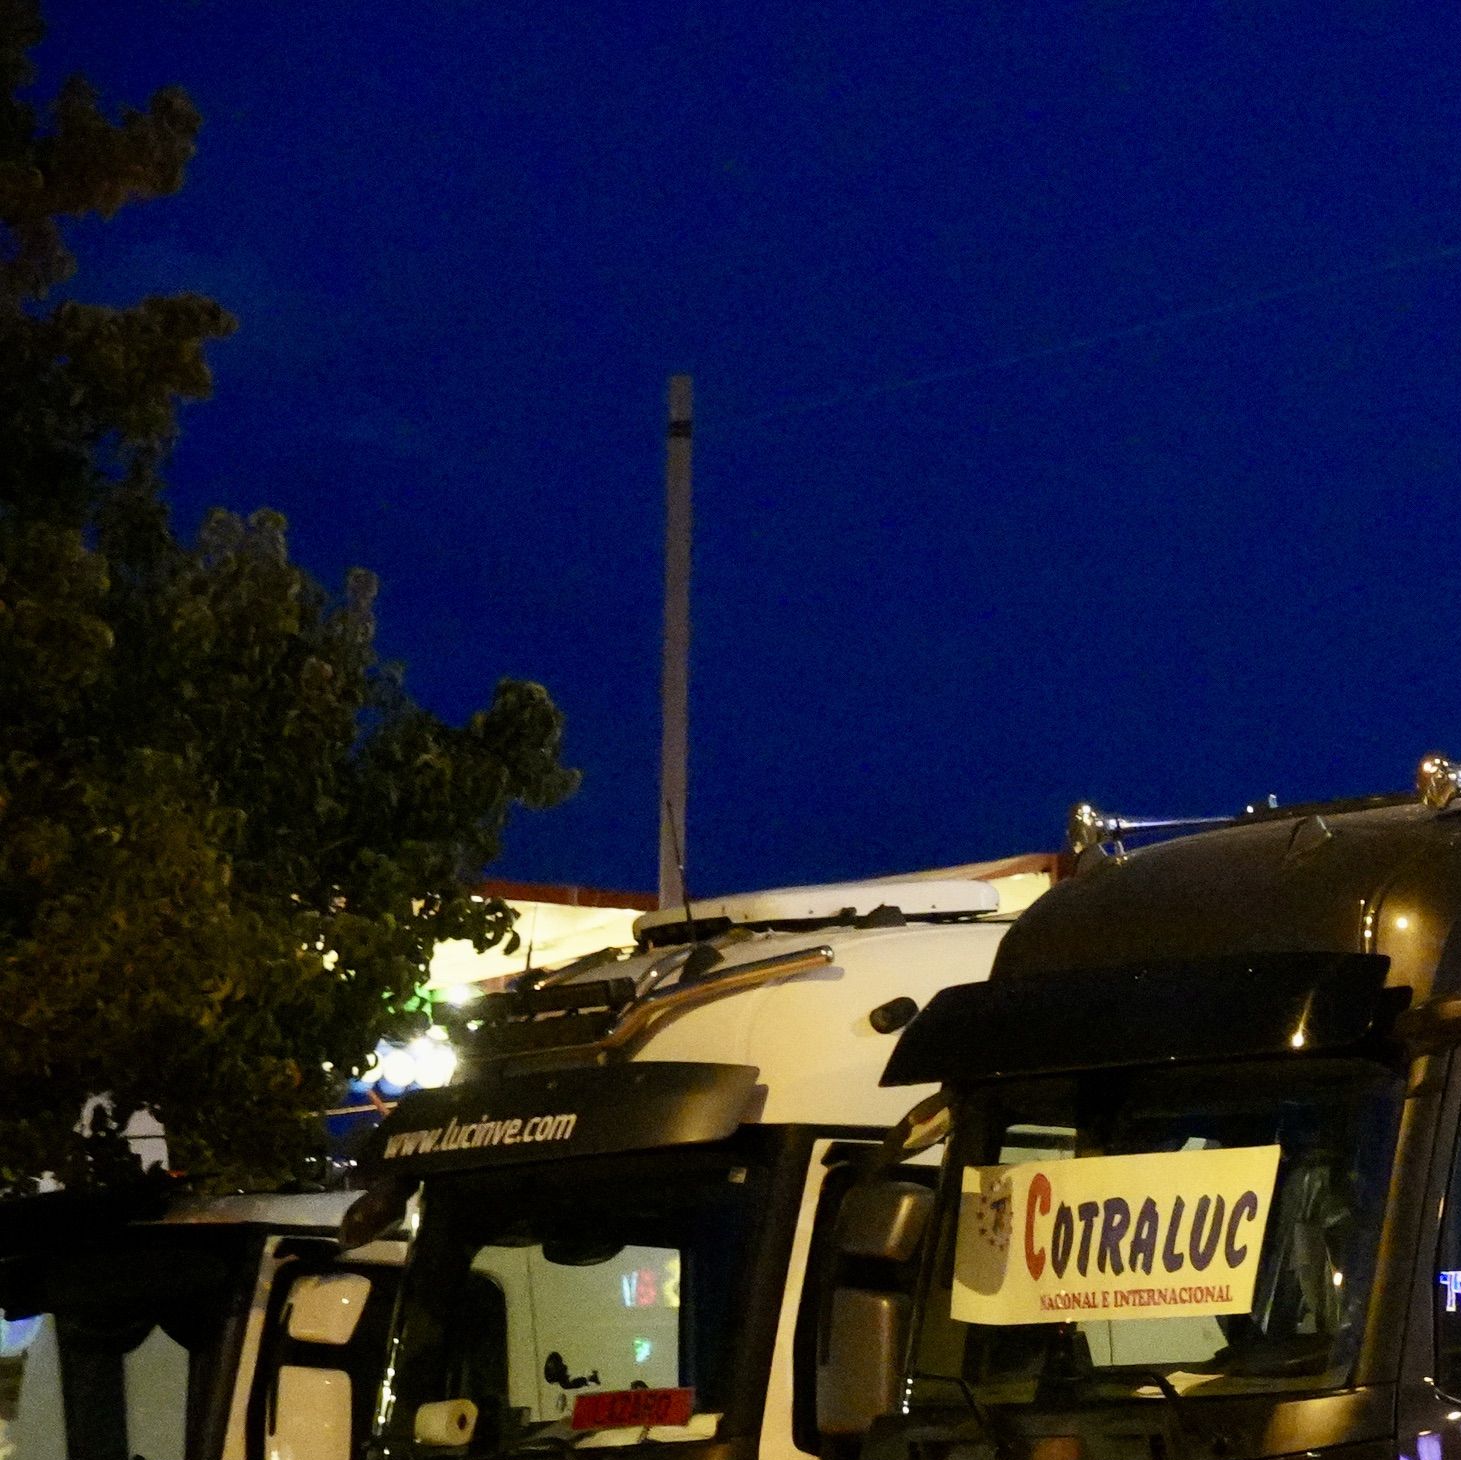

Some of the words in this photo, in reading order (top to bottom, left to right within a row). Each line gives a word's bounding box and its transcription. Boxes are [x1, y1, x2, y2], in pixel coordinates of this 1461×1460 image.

[384, 1113, 578, 1159] www.lucinve.com
[1024, 1172, 1258, 1281] COTRALUC
[1102, 1290, 1110, 1308] E
[1114, 1285, 1233, 1308] INTERNACIONAL
